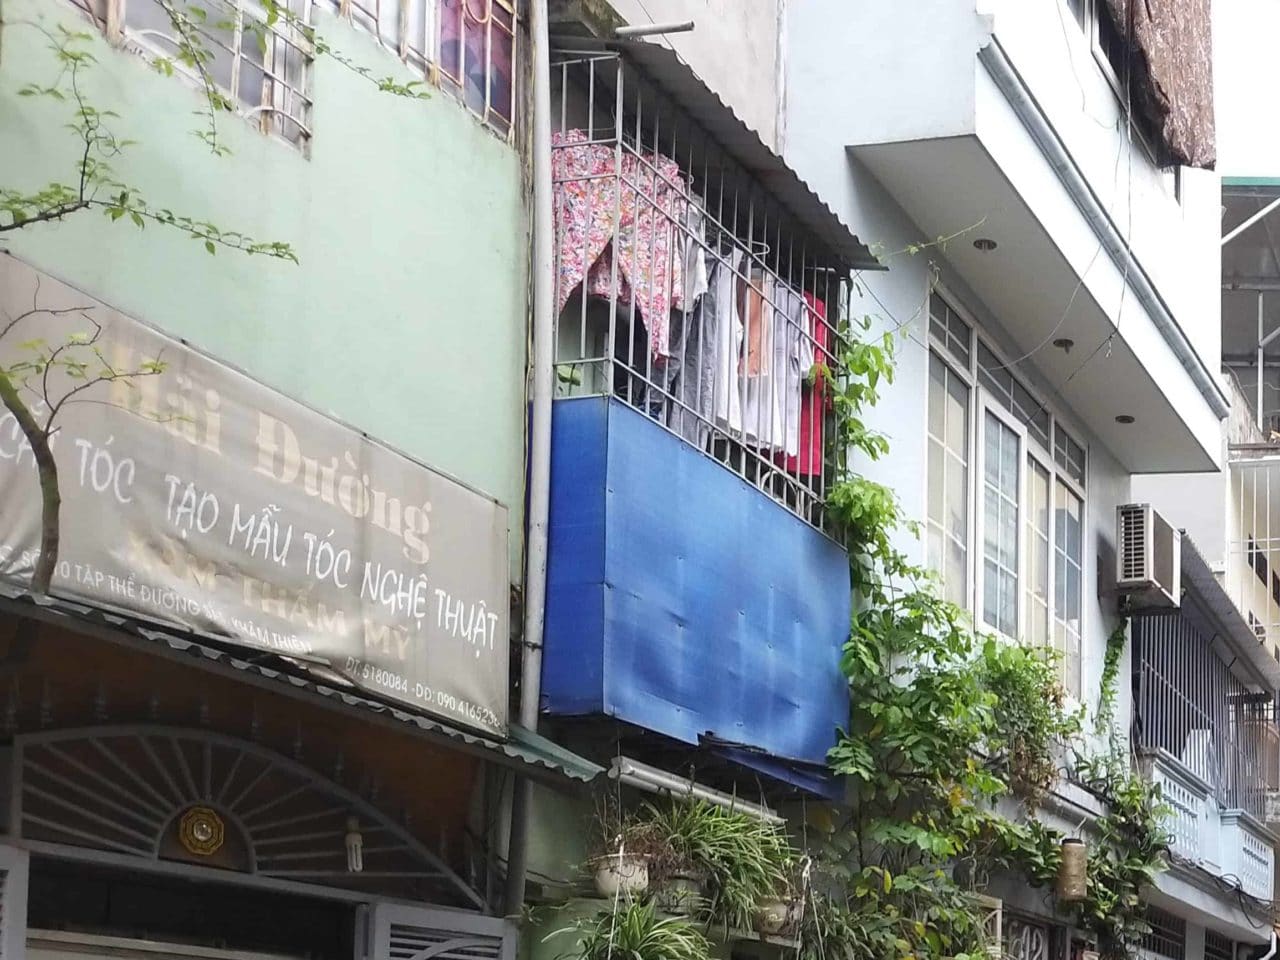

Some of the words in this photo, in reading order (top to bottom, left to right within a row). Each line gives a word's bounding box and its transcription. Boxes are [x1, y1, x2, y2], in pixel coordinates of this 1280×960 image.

[76, 434, 135, 504] TÓC
[165, 474, 219, 538] TẠO
[228, 504, 292, 567] MẪU
[304, 529, 351, 589] TÓC
[360, 561, 428, 630] NGHỆ
[435, 588, 499, 659] THUẬT
[253, 410, 431, 565] Đường
